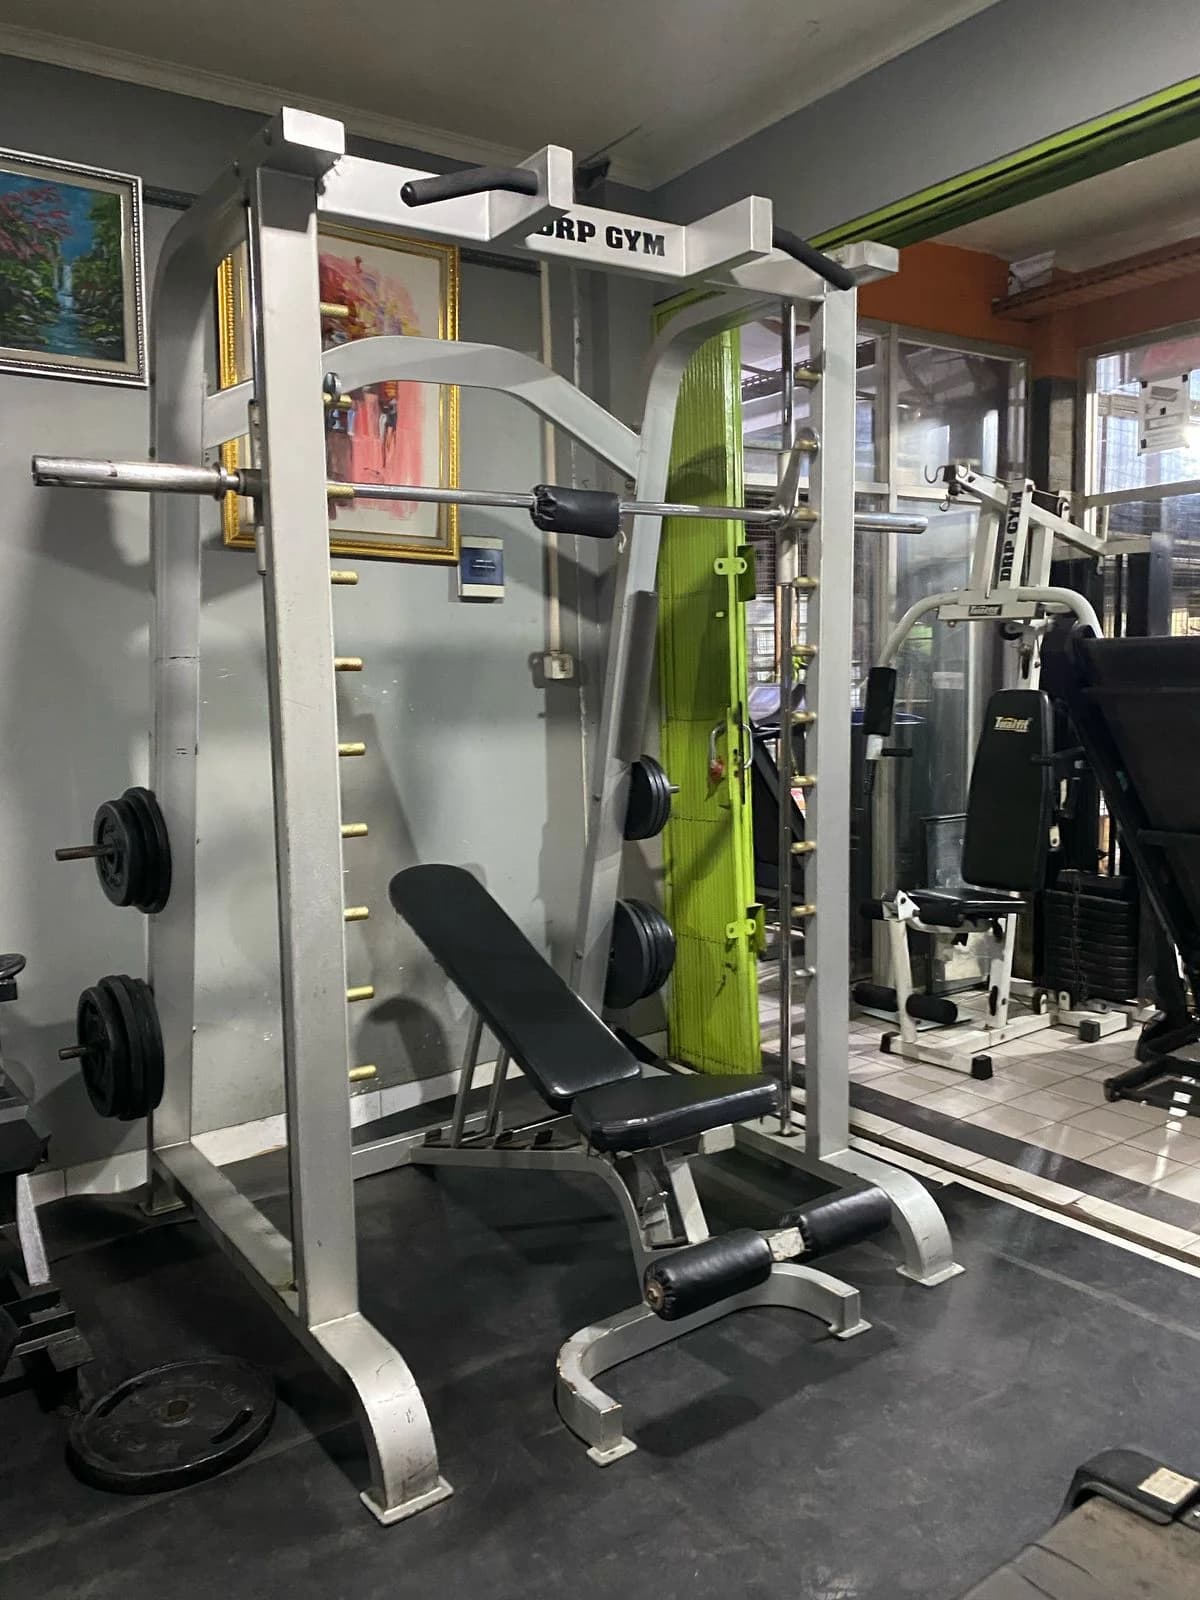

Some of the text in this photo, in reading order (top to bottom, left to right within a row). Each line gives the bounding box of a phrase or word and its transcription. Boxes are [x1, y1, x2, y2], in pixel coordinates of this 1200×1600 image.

[605, 226, 666, 257] GYM
[1000, 491, 1022, 582] DRP GYM
